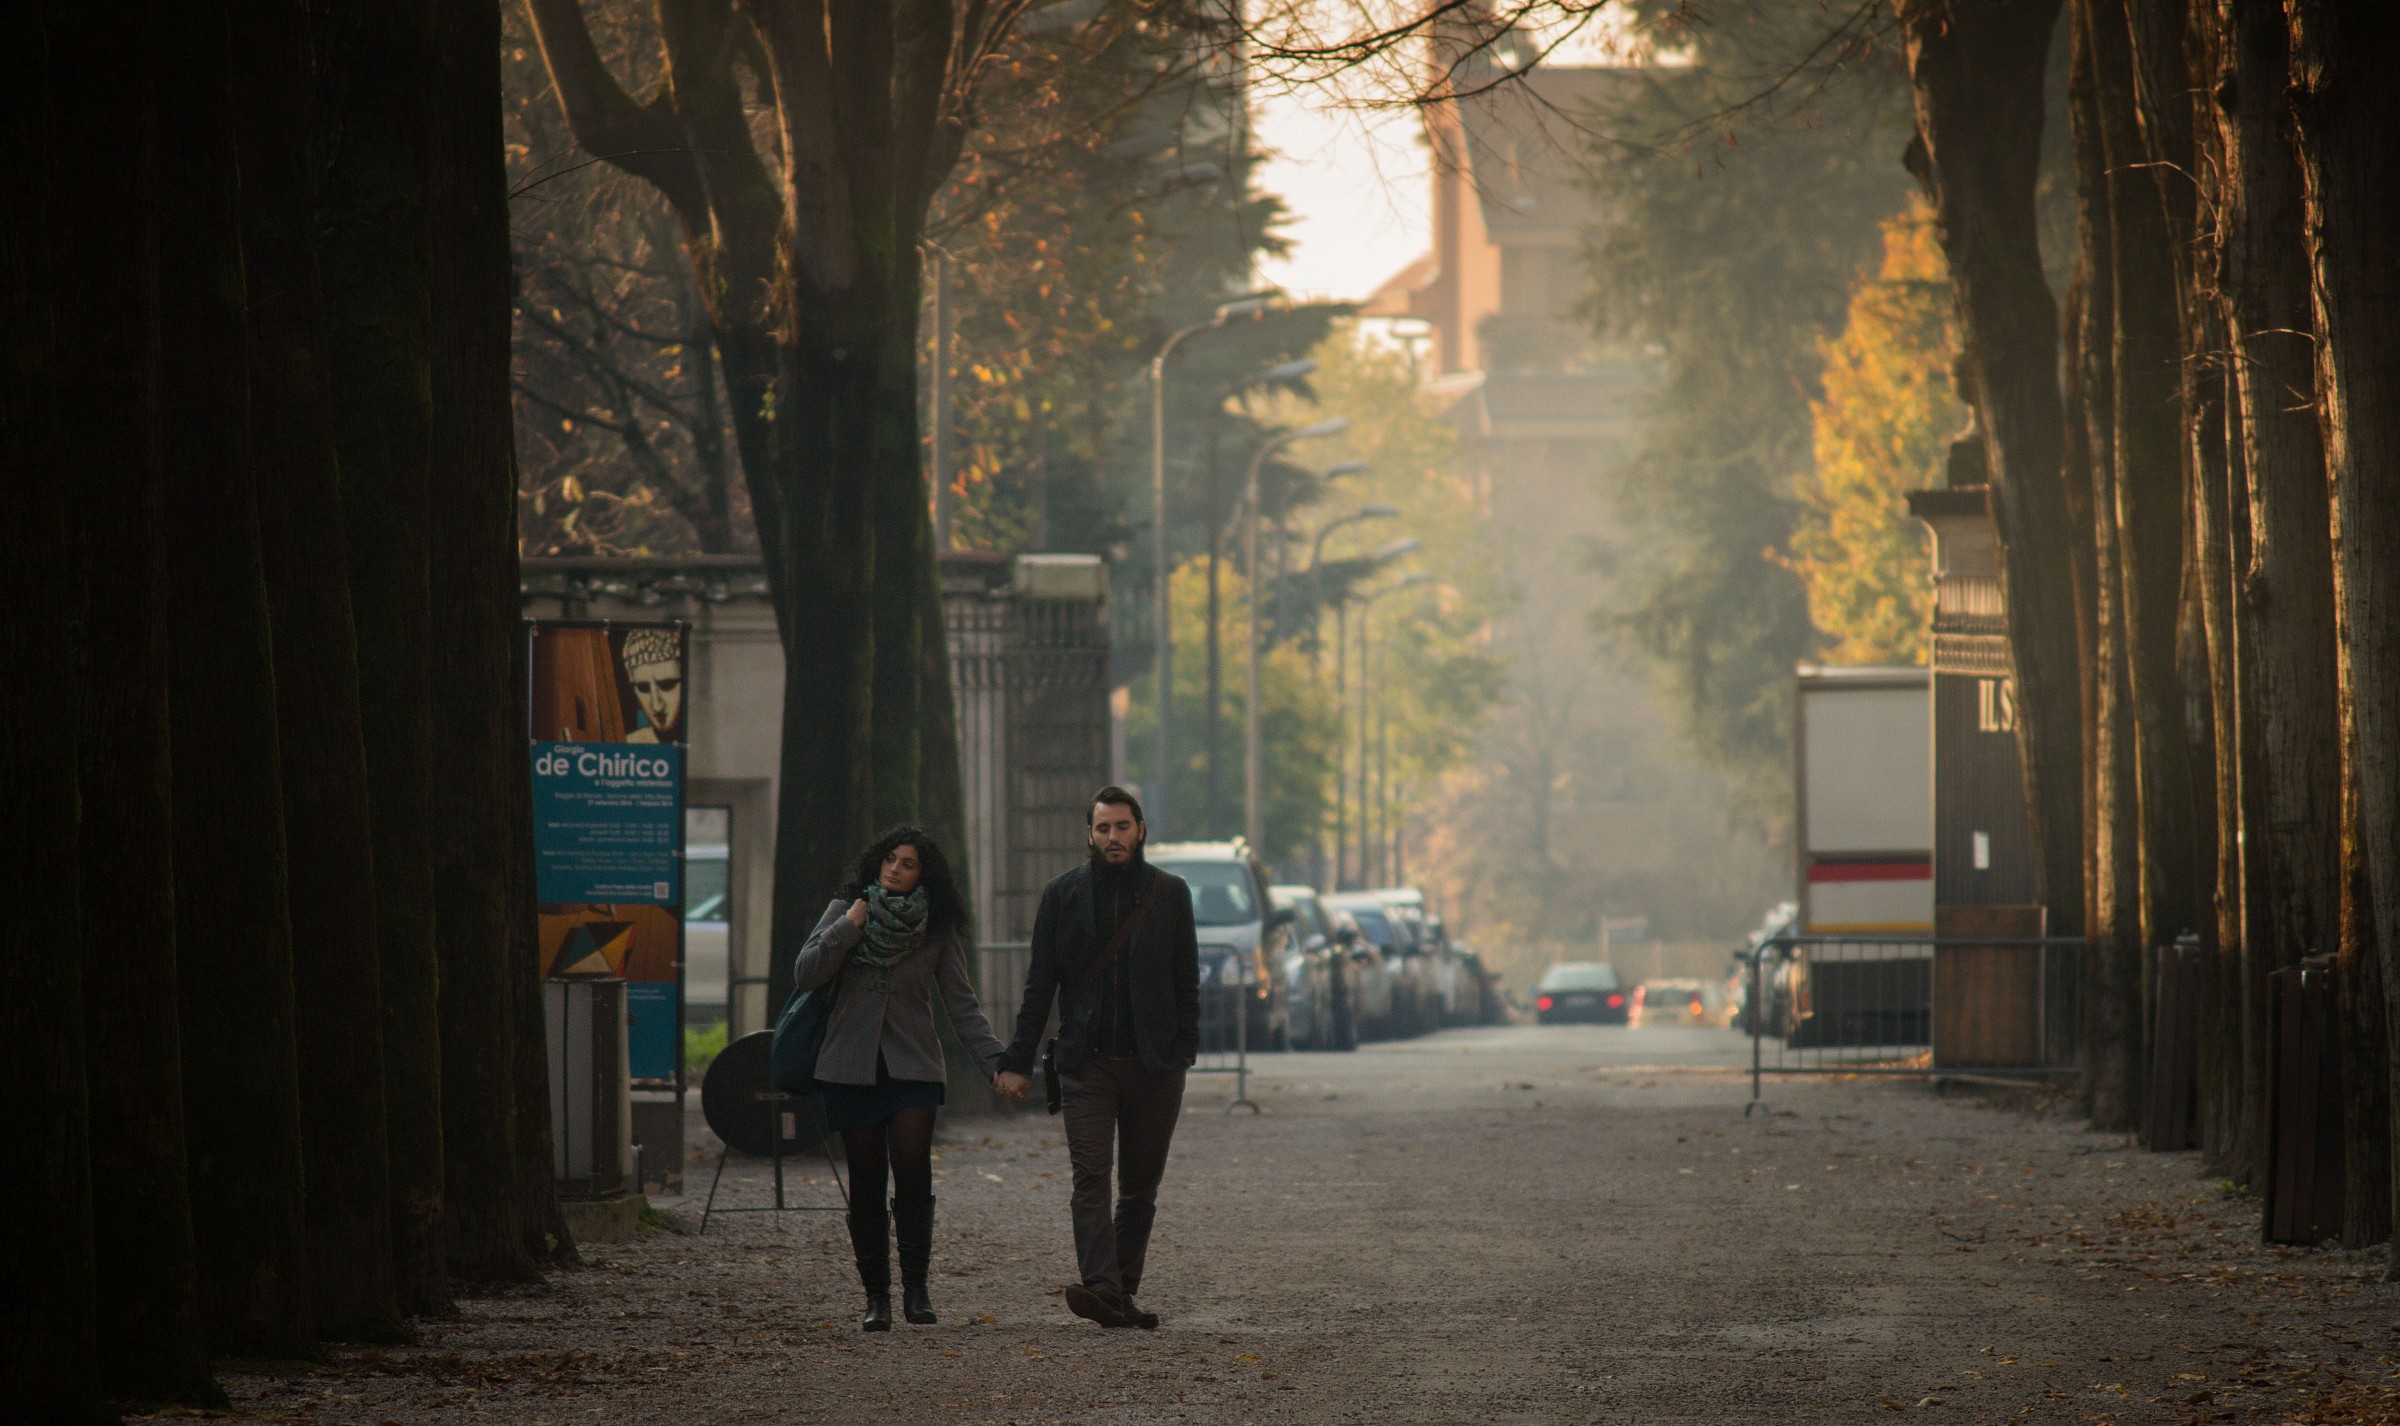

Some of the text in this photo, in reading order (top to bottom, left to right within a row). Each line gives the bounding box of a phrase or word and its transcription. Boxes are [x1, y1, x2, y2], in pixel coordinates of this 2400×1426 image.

[554, 744, 585, 755] Giorgio
[535, 751, 669, 777] de Chirico
